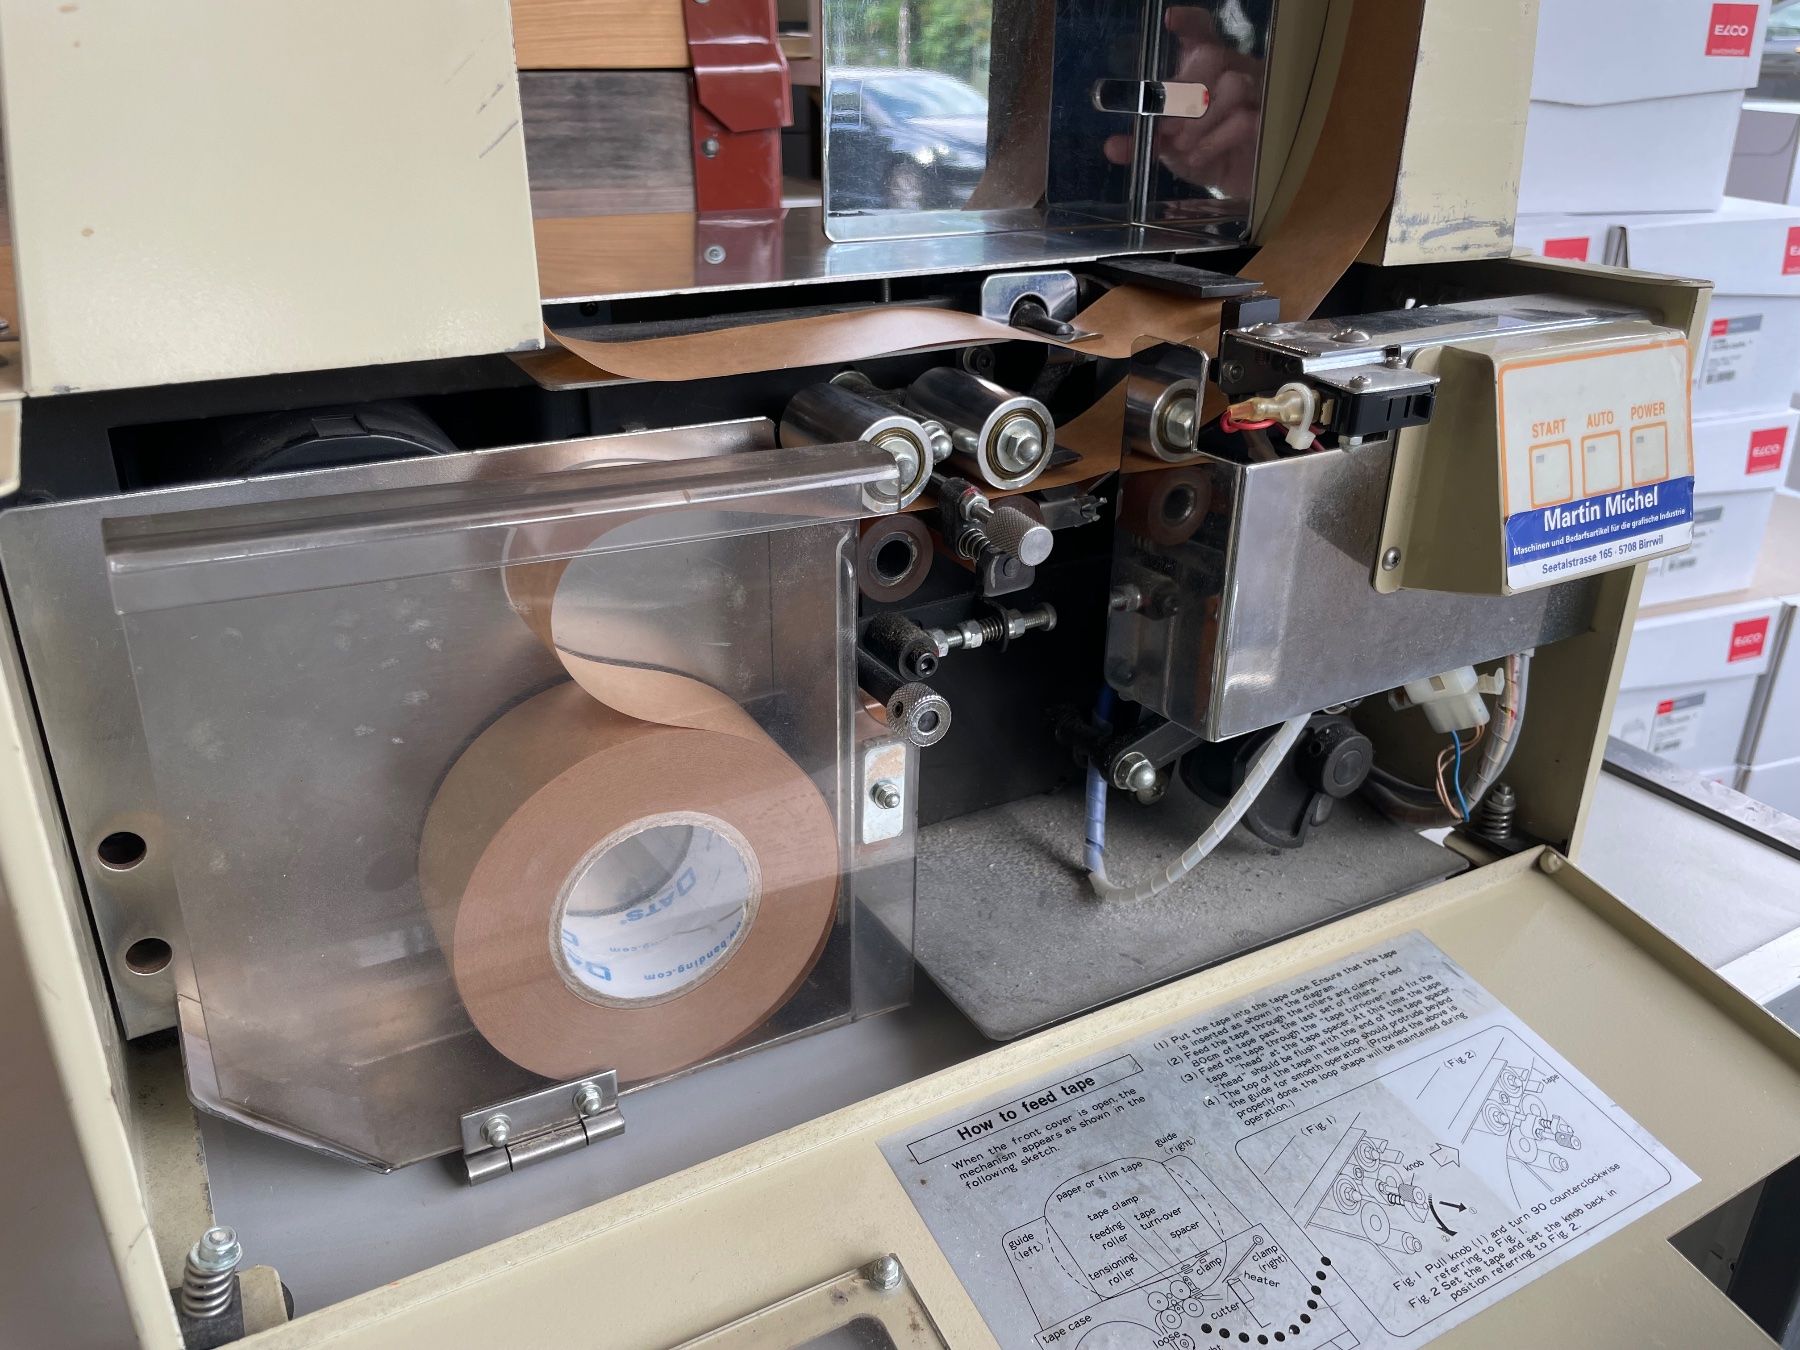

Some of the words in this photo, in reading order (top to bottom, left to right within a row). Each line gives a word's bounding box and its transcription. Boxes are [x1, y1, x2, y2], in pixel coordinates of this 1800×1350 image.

[1714, 24, 1748, 37] ELCO
[1532, 419, 1566, 439] START
[1587, 411, 1614, 429] AUTO
[1630, 402, 1665, 420] POWER
[1544, 502, 1600, 532] Martin
[1605, 486, 1658, 518] Michel
[1513, 542, 1550, 556] Maschinen
[1551, 537, 1565, 547] und
[1565, 527, 1610, 544] Bedarfsartikel
[1610, 524, 1620, 533] für
[1620, 521, 1631, 530] die
[1631, 515, 1659, 529] grafische
[1660, 508, 1686, 520] Industrie
[1542, 553, 1597, 574] Seetalstrasse
[1599, 547, 1613, 560] 165
[1618, 541, 1637, 555] 5708
[1638, 535, 1664, 550] Birrwil
[1170, 1033, 1190, 1044] Put
[1192, 1026, 1209, 1035] the
[1210, 1017, 1231, 1027] tape
[1231, 1009, 1251, 1019] into
[1251, 1002, 1268, 1011] the
[1268, 994, 1289, 1004] tape
[1311, 972, 1342, 987] Ensure
[1343, 964, 1362, 974] that
[1363, 957, 1378, 966] the
[1378, 950, 1397, 960] tape
[1167, 1056, 1184, 1067] (2)
[1184, 1045, 1210, 1059] Feed
[1211, 1039, 1228, 1048] the
[1229, 1030, 1250, 1041] tape
[1252, 1015, 1286, 1031] through
[1287, 1008, 1303, 1017] the
[1304, 996, 1333, 1011] rollers
[1335, 987, 1350, 998] and
[1379, 966, 1402, 978] Feed
[1203, 1096, 1220, 1108] (4)
[1220, 1089, 1240, 1099] The
[1242, 1081, 1259, 1091] top
[1260, 1074, 1270, 1084] of
[1273, 1068, 1290, 1077] the
[1291, 1058, 1312, 1069] tape
[1323, 1046, 1340, 1055] the
[1340, 1037, 1360, 1048] loop
[1361, 1024, 1388, 1040] should
[1389, 1010, 1424, 1029] protrude
[1423, 996, 1453, 1012] beyond
[1228, 1098, 1246, 1108] the
[1248, 1087, 1272, 1102] guide
[1273, 1079, 1287, 1089] for
[1291, 1064, 1323, 1081] smooth
[1324, 1046, 1367, 1067] operation.
[1367, 1026, 1408, 1048] (Provided
[1408, 1020, 1424, 1029] the
[1425, 1010, 1448, 1023] above
[1236, 1097, 1275, 1119] properly
[1277, 1087, 1302, 1099] done,
[1301, 1078, 1318, 1088] the
[1318, 1069, 1338, 1080] loop
[1340, 1057, 1365, 1071] shape
[1366, 1048, 1383, 1059] will
[1382, 1044, 1396, 1052] be
[1396, 1023, 1440, 1046] maintained
[1441, 1012, 1468, 1026] during
[1542, 1074, 1559, 1084] tape
[957, 1120, 993, 1140] How
[999, 1110, 1017, 1122] to
[1022, 1091, 1057, 1112] feed
[1061, 1078, 1095, 1095] tape
[1244, 1099, 1295, 1126] operation.)
[951, 1154, 984, 1169] When
[988, 1144, 1007, 1155] the
[1012, 1129, 1041, 1144] front
[1045, 1115, 1072, 1131] cover
[1078, 1109, 1088, 1117] is
[1092, 1098, 1118, 1111] open,
[1118, 1089, 1136, 1099] the
[959, 1152, 1016, 1180] mechanism
[1022, 1132, 1062, 1153] appears
[1065, 1126, 1077, 1135] as
[1079, 1111, 1110, 1128] shown
[1114, 1105, 1125, 1113] in
[1128, 1096, 1145, 1107] the
[1155, 1133, 1177, 1148] guide
[966, 1164, 1018, 1189] following
[1021, 1146, 1060, 1165] sketch.
[1403, 1160, 1424, 1171] knob
[1056, 1186, 1081, 1202] paper
[1085, 1180, 1094, 1188] or
[1099, 1171, 1119, 1182] film
[1121, 1161, 1143, 1173] tape
[1087, 1209, 1109, 1221] tape
[1112, 1196, 1138, 1211] clamp
[1134, 1208, 1156, 1221] tape
[1140, 1207, 1181, 1230] turn-over
[1425, 1257, 1447, 1273] Pull
[1447, 1245, 1472, 1260] knob
[1490, 1225, 1507, 1241] and
[1508, 1213, 1530, 1227] turn
[1531, 1203, 1547, 1215] 90
[1550, 1164, 1620, 1205] counterclockwise
[1008, 1234, 1034, 1250] guide
[1090, 1221, 1125, 1242] feeding
[1102, 1234, 1127, 1250] roller
[1170, 1222, 1199, 1238] spacer
[1441, 1277, 1462, 1290] Set
[1464, 1266, 1482, 1278] the
[1480, 1253, 1505, 1267] tape
[1508, 1240, 1525, 1254] and
[1526, 1232, 1543, 1243] set
[1544, 1221, 1561, 1233] the
[1561, 1208, 1584, 1222] knob
[1584, 1196, 1606, 1210] back
[1607, 1189, 1617, 1197] in
[1088, 1253, 1138, 1280] tensioning
[1196, 1257, 1222, 1275] clamp
[1252, 1245, 1278, 1261] clamp
[1434, 1253, 1483, 1284] referring
[1482, 1246, 1495, 1255] to
[1495, 1235, 1516, 1247] Fig.
[1450, 1275, 1490, 1302] position
[1491, 1249, 1535, 1276] referring
[1534, 1242, 1547, 1251] to
[1547, 1230, 1568, 1243] Fig.
[1568, 1222, 1581, 1232] 2.
[1108, 1268, 1134, 1286] roller
[1243, 1271, 1281, 1290] heater
[1211, 1302, 1239, 1320] cutter
[1042, 1328, 1066, 1343] tape
[1068, 1315, 1091, 1331] case
